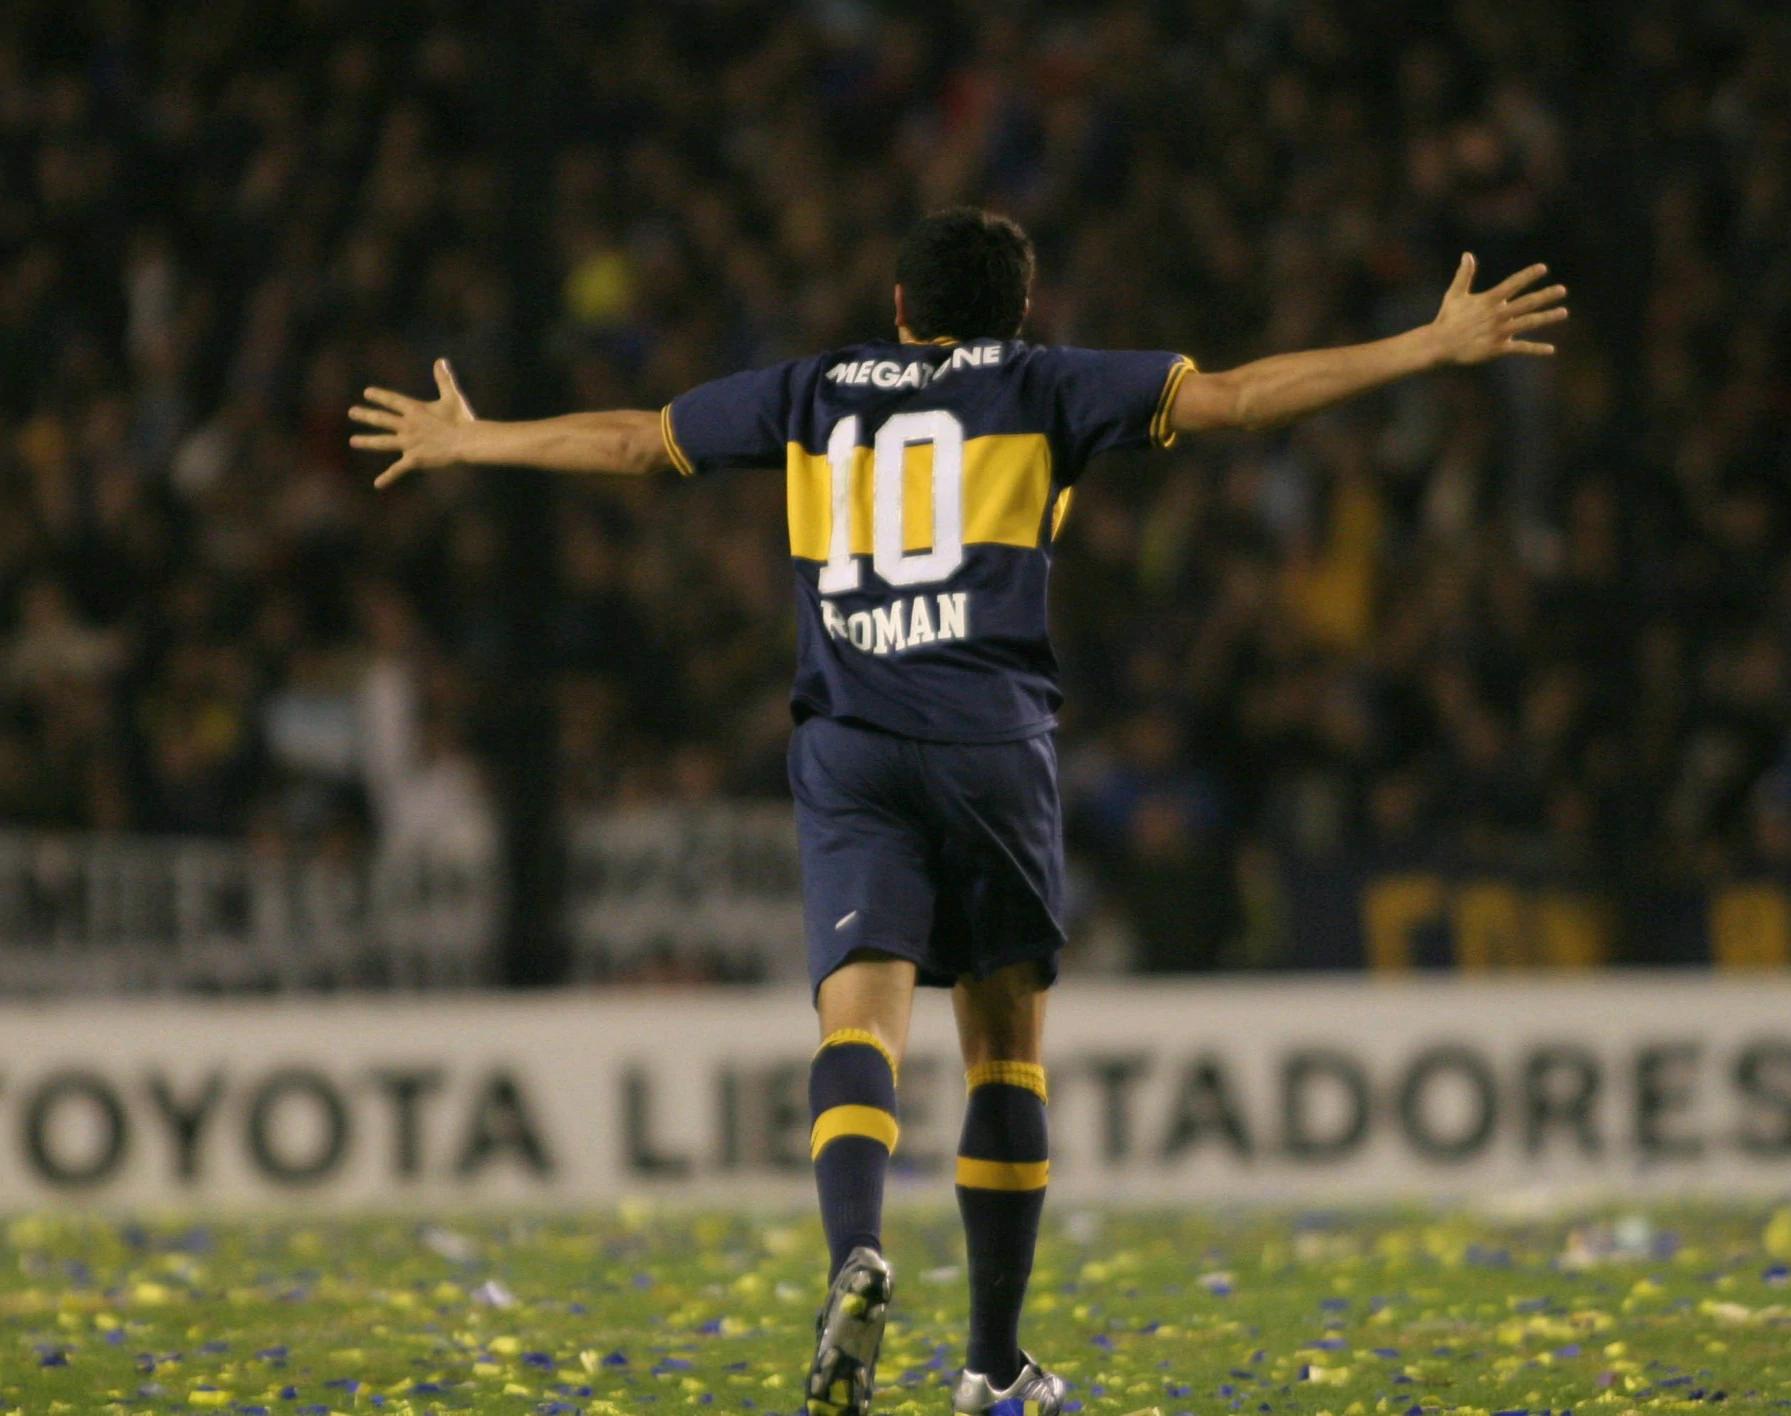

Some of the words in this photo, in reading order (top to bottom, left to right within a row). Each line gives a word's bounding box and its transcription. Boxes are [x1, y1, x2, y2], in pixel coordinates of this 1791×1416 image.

[818, 409, 963, 594] 10
[820, 592, 967, 655] ROMAN
[0, 1067, 553, 1188] OYOTA
[622, 1042, 1791, 1179] LIBETADORES
